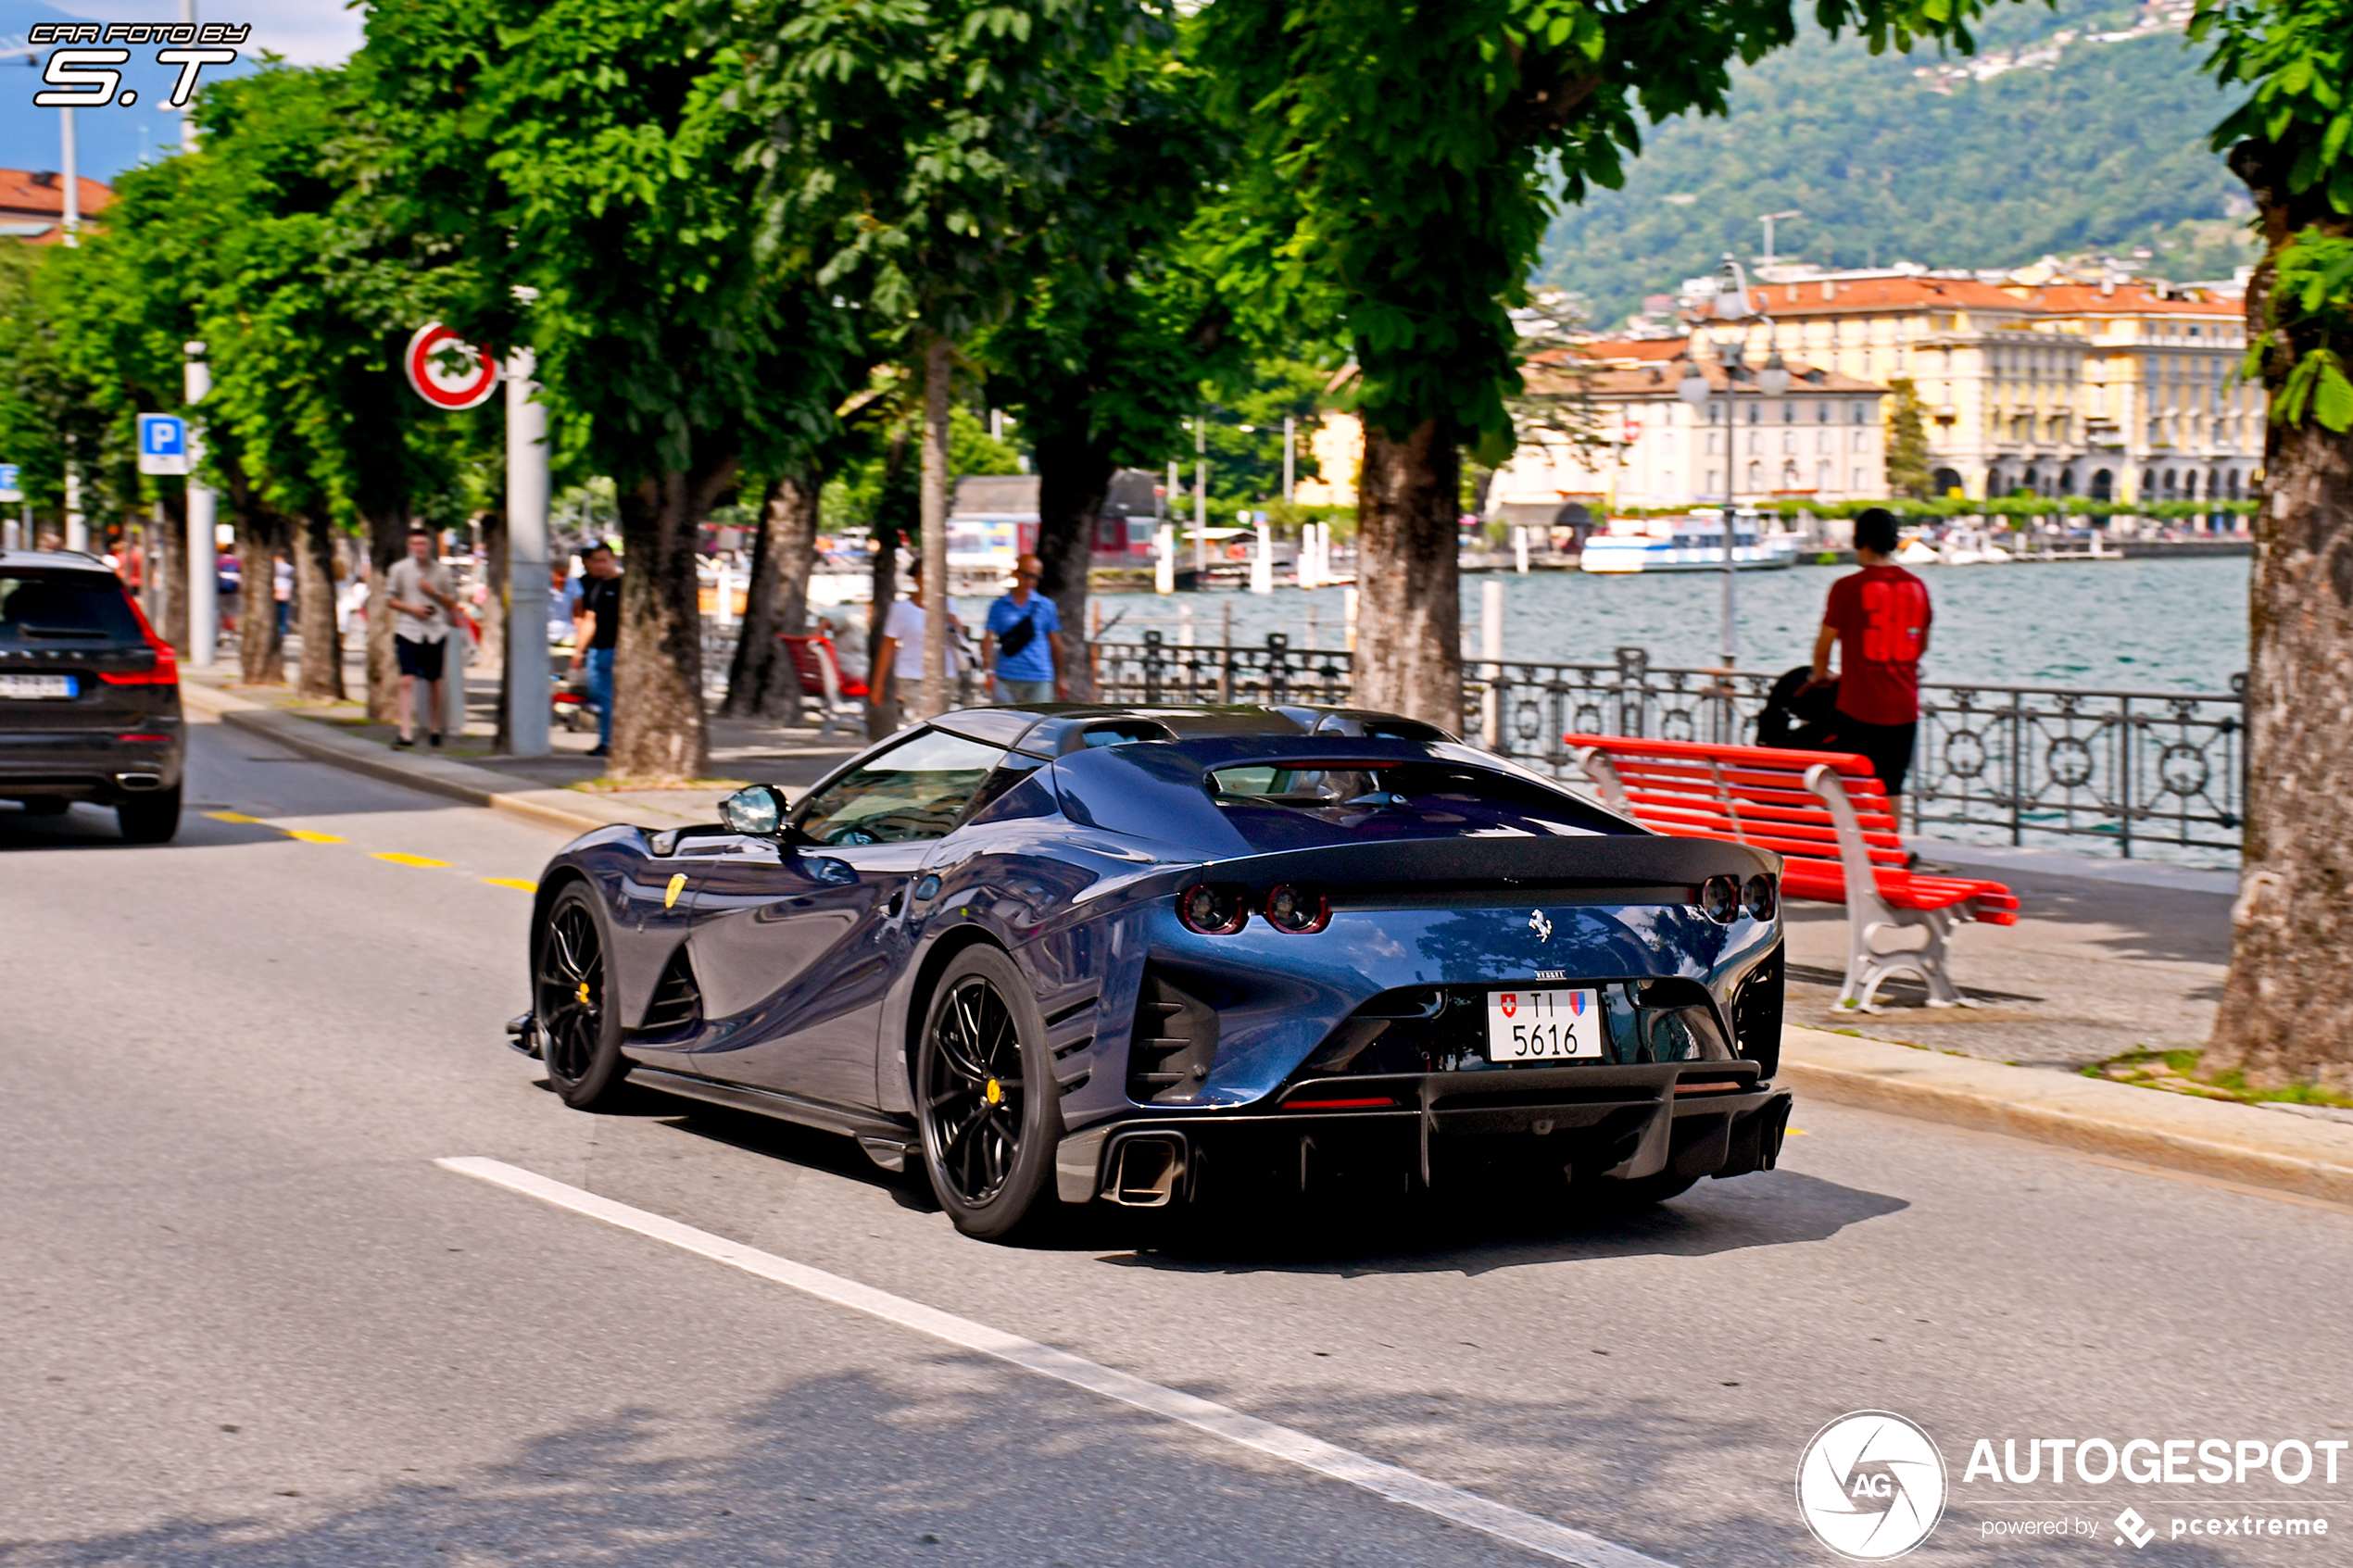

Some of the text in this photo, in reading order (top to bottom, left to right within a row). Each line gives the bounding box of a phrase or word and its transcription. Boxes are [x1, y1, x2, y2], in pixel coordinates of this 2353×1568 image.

[151, 421, 176, 452] P
[1861, 581, 1925, 661] 30
[1530, 992, 1554, 1018] TI
[1513, 1022, 1578, 1056] 5616
